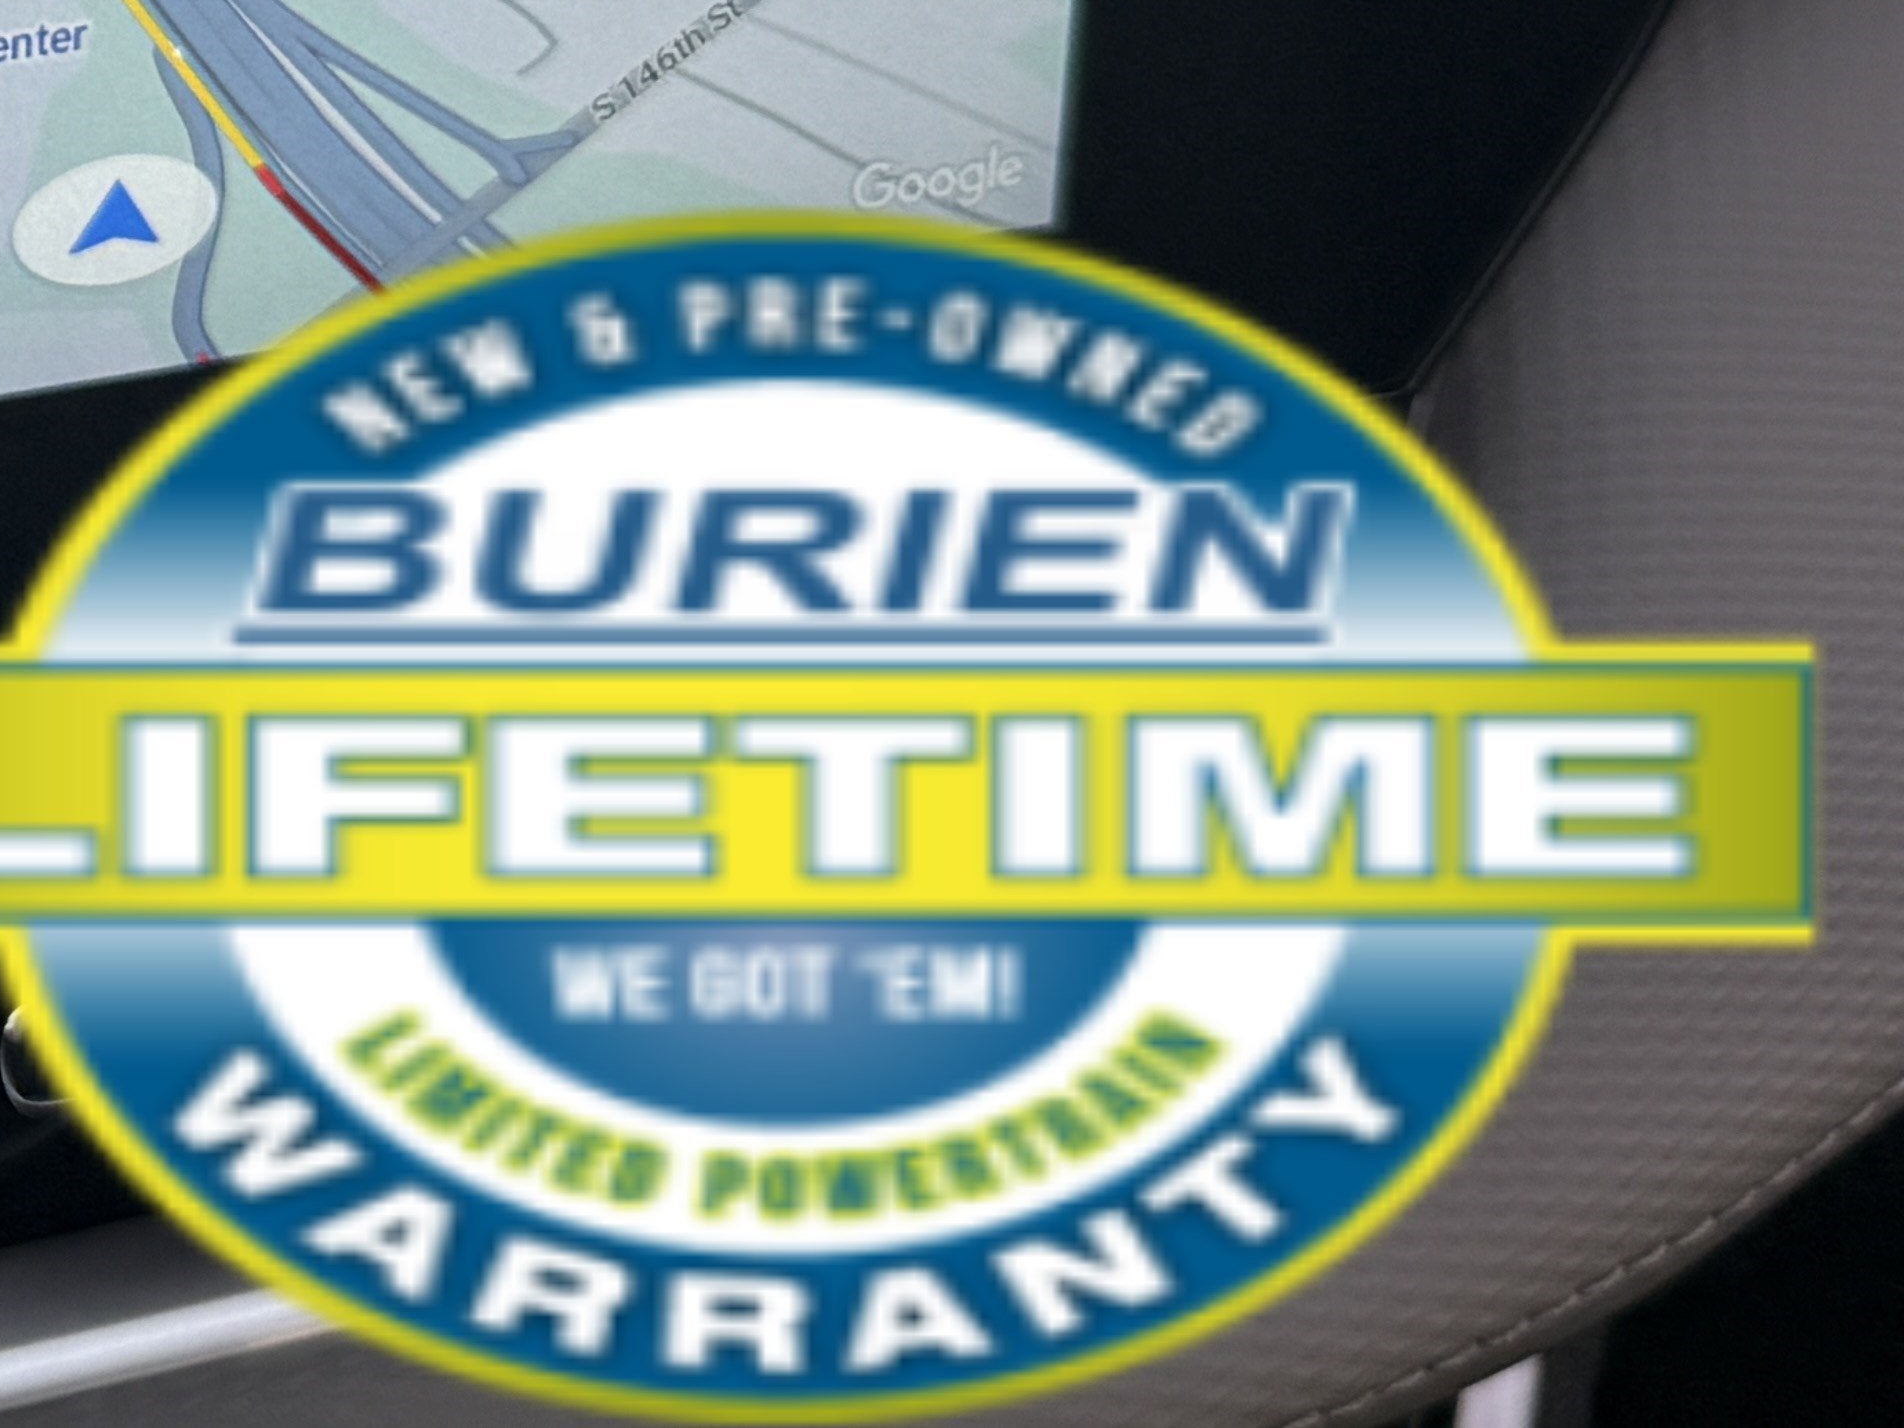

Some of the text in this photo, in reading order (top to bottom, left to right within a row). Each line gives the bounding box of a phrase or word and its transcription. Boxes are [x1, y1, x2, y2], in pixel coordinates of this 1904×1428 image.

[592, 91, 618, 121] S
[620, 26, 706, 98] 146th
[854, 147, 1025, 209] Google
